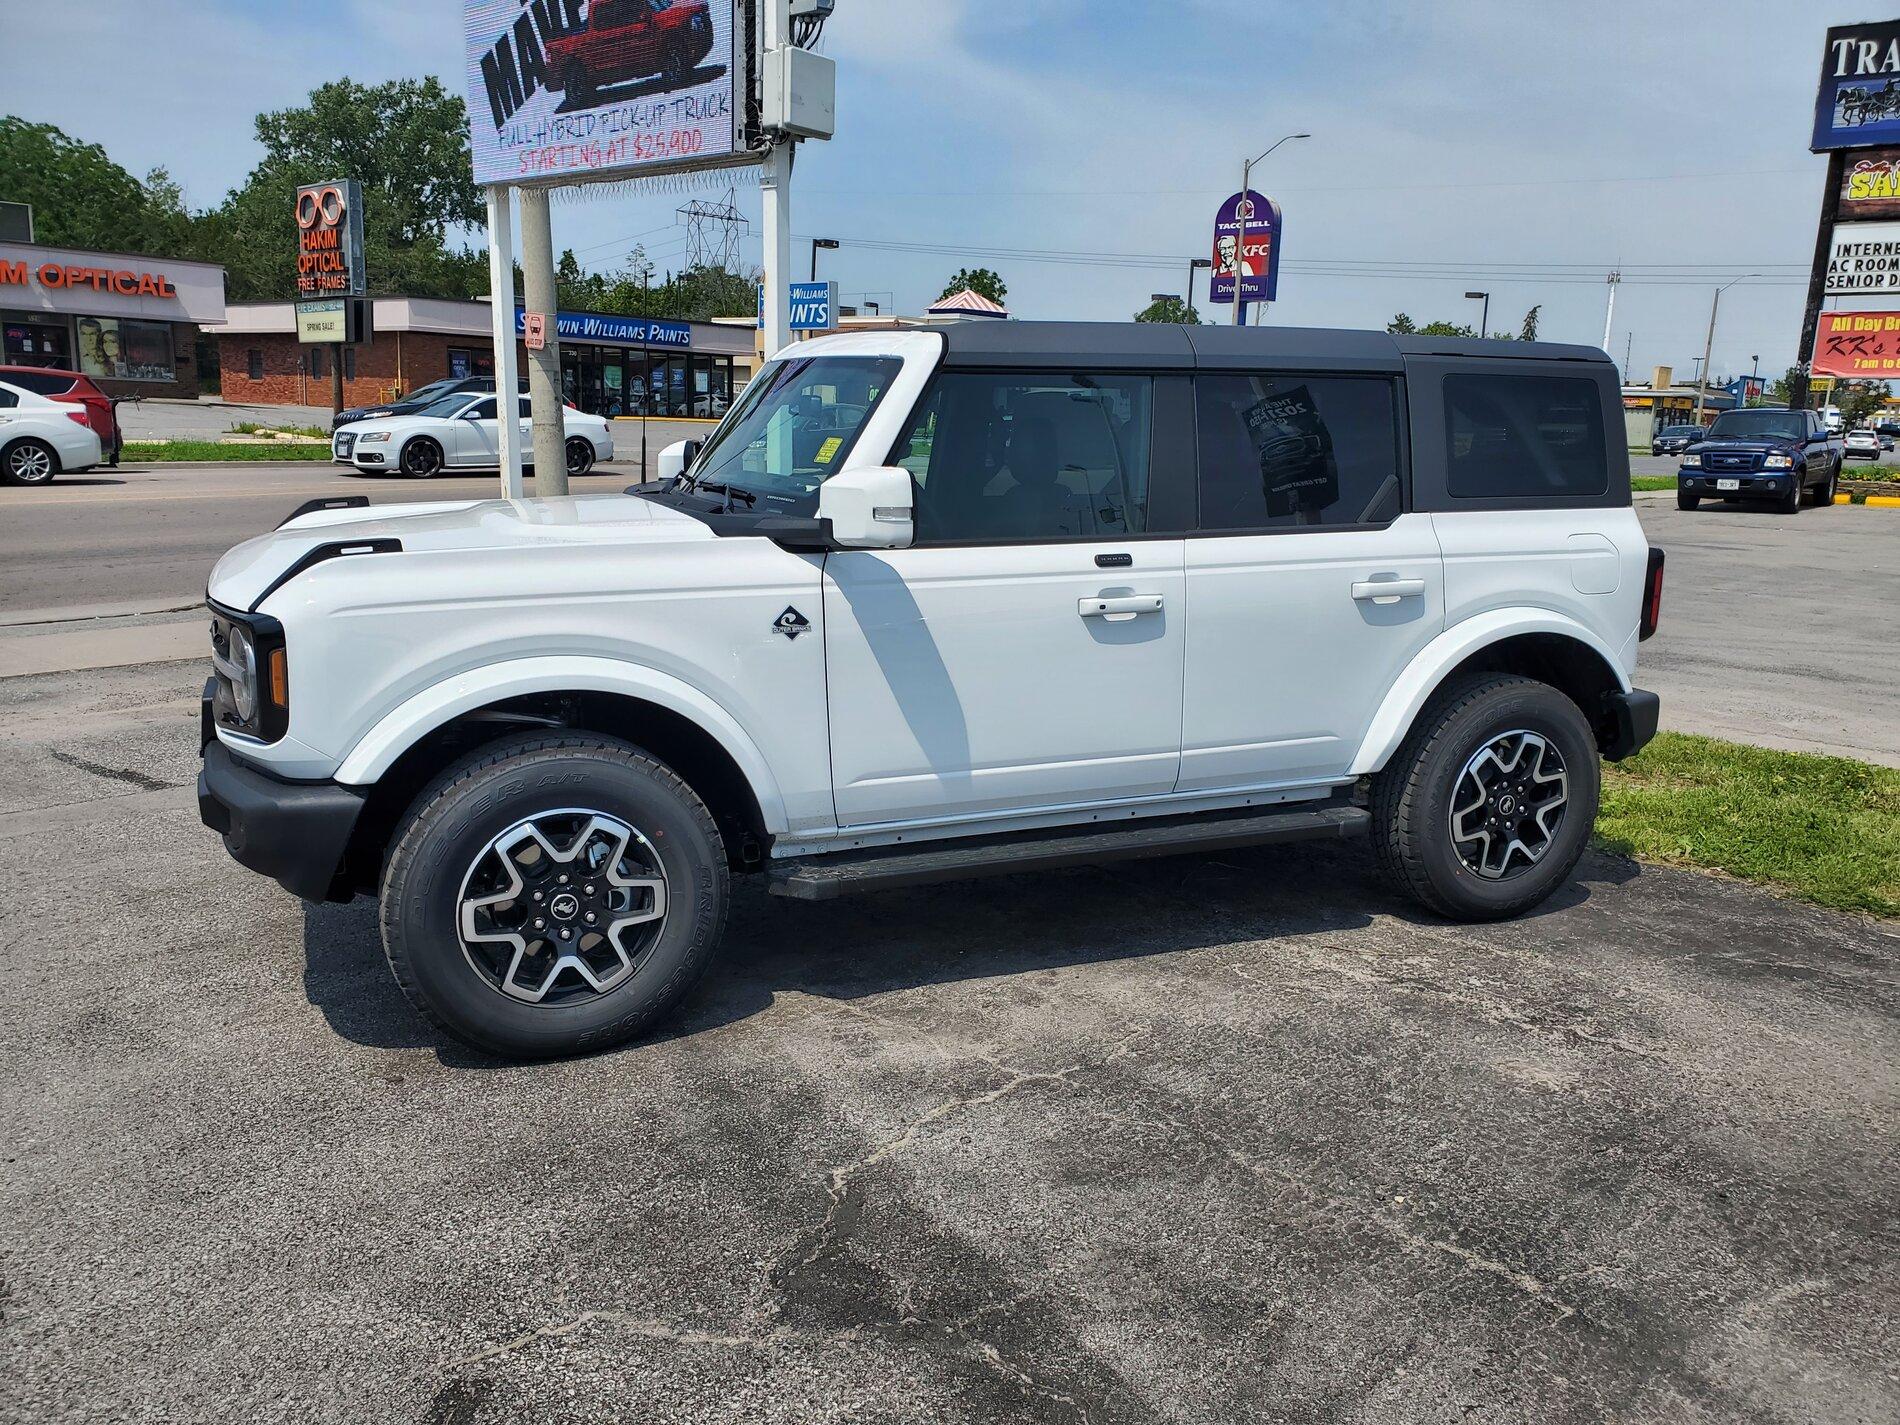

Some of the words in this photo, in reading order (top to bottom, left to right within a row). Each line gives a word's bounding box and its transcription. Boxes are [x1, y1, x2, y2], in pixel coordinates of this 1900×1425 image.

[671, 90, 729, 122] TRUCK
[519, 140, 602, 172] STARTING
[606, 136, 628, 164] AT
[634, 128, 703, 159] $25,900
[1246, 220, 1270, 228] BELL
[301, 229, 337, 250] HAKIM
[1241, 244, 1270, 256] KFC
[298, 251, 344, 273] OPTICAL
[1829, 259, 1848, 273] AC
[38, 263, 176, 298] OPTICAL
[298, 277, 315, 290] FREE
[317, 275, 346, 289] FRAMES
[1241, 283, 1258, 292] Thru
[1826, 274, 1884, 288] SENIOR
[1831, 317, 1851, 331] All
[1854, 317, 1882, 333] Day
[649, 325, 690, 344] PAINTS
[1883, 358, 1895, 369] to
